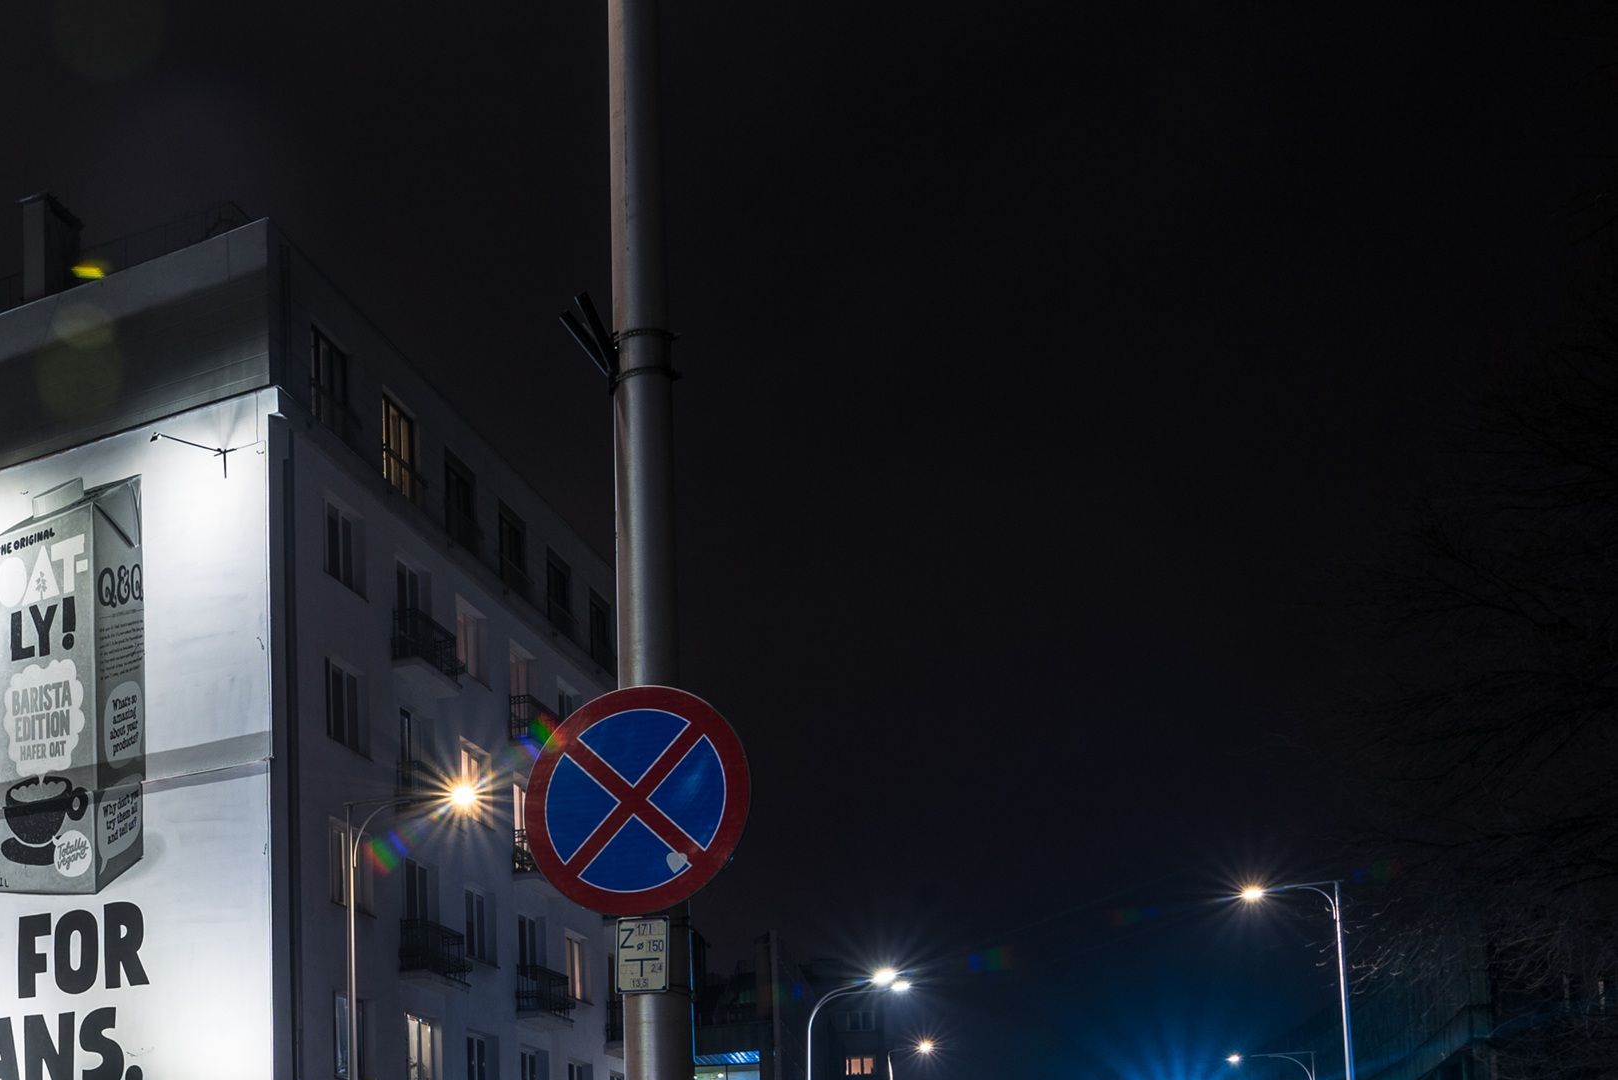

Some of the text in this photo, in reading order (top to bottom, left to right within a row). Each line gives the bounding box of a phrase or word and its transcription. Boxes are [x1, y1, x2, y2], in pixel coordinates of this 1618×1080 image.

[13, 527, 55, 551] ORIGINAL
[11, 596, 76, 661] LY!
[12, 680, 72, 716] BARISTA
[112, 695, 131, 711] What's
[15, 709, 70, 743] EDITION
[113, 706, 137, 725] amazing
[110, 720, 139, 740] about your
[20, 740, 67, 761] HAFER OAT
[113, 731, 139, 756] products?
[103, 803, 117, 818] Why
[117, 793, 130, 810] don't
[106, 818, 116, 831] try
[117, 809, 131, 824] them
[107, 829, 118, 845] and
[119, 822, 128, 838] tell
[57, 838, 89, 859] Totally
[620, 928, 634, 949] Z
[647, 940, 664, 952] 150
[18, 901, 150, 999] FOR
